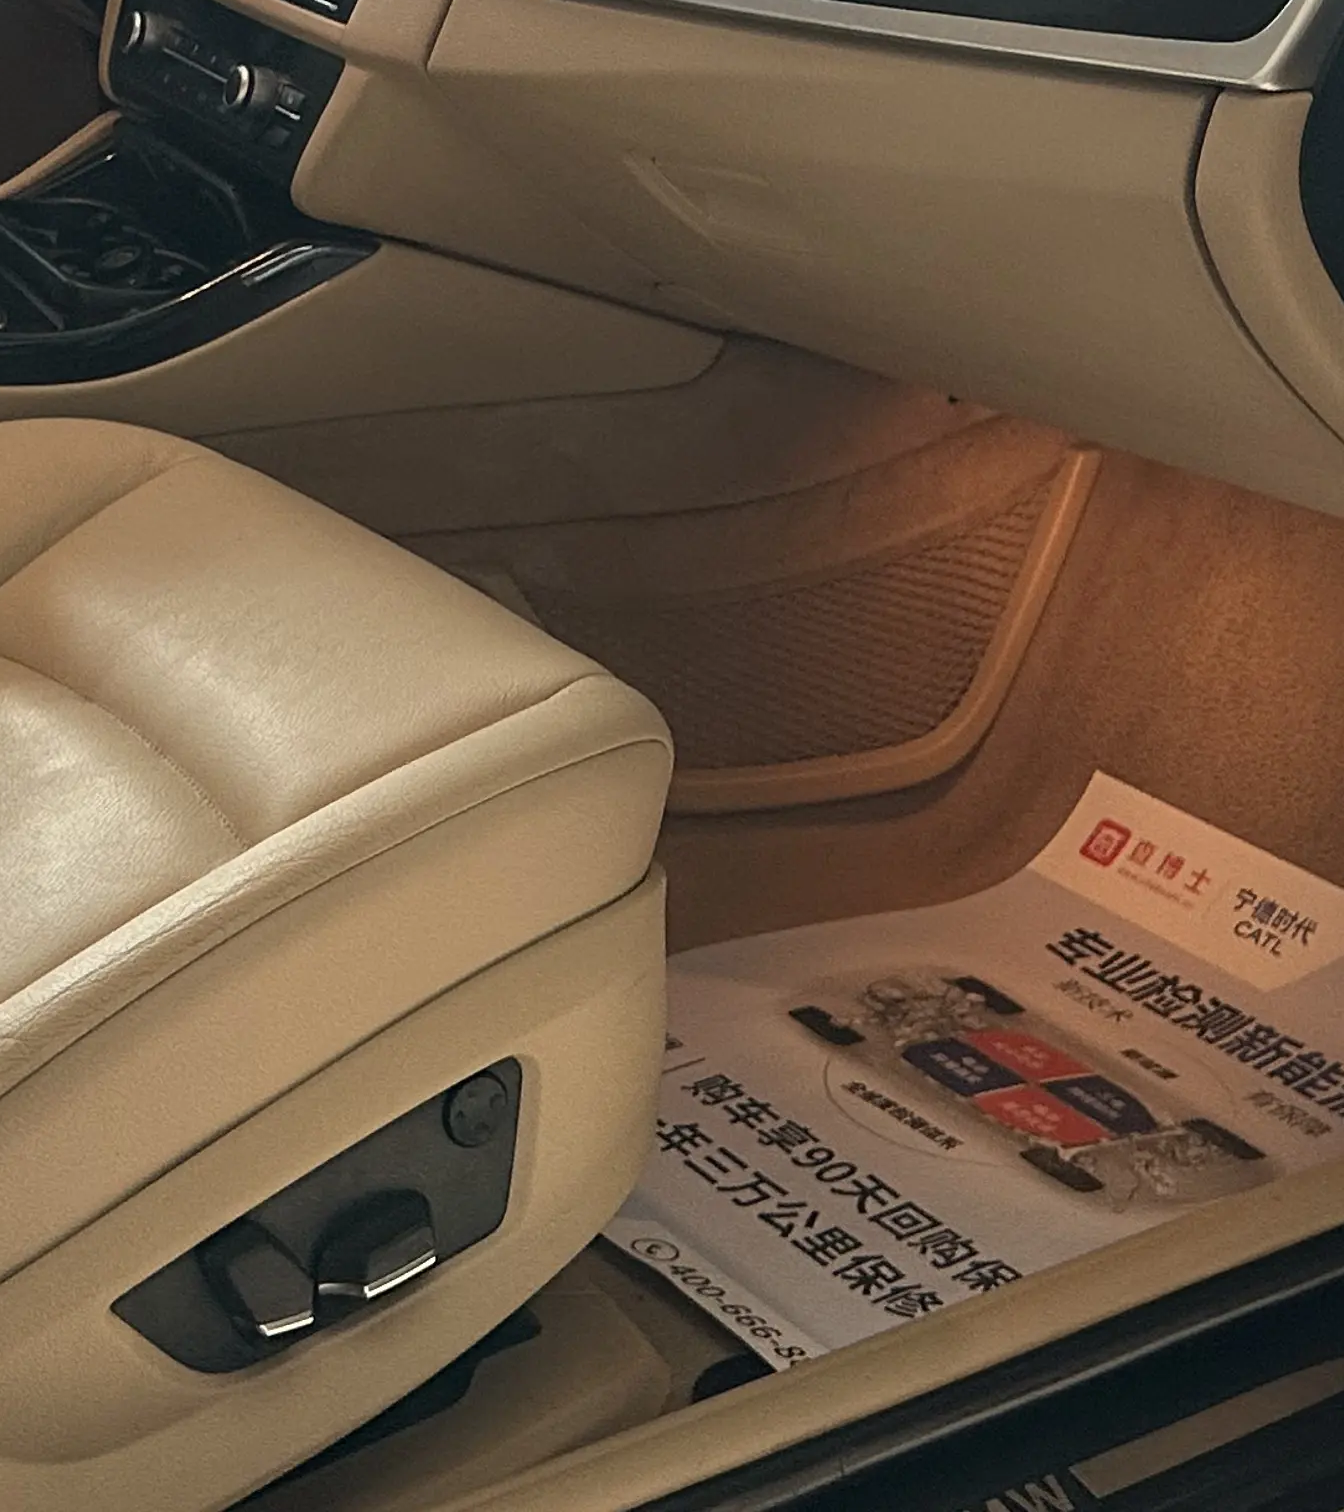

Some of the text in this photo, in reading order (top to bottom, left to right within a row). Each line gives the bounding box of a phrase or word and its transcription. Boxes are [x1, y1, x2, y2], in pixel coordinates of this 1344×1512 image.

[1233, 888, 1319, 946] 宁德时代
[1233, 920, 1284, 957] CATL
[655, 1118, 946, 1319] 年三万公里保修
[668, 1259, 811, 1369] 400-666-8
